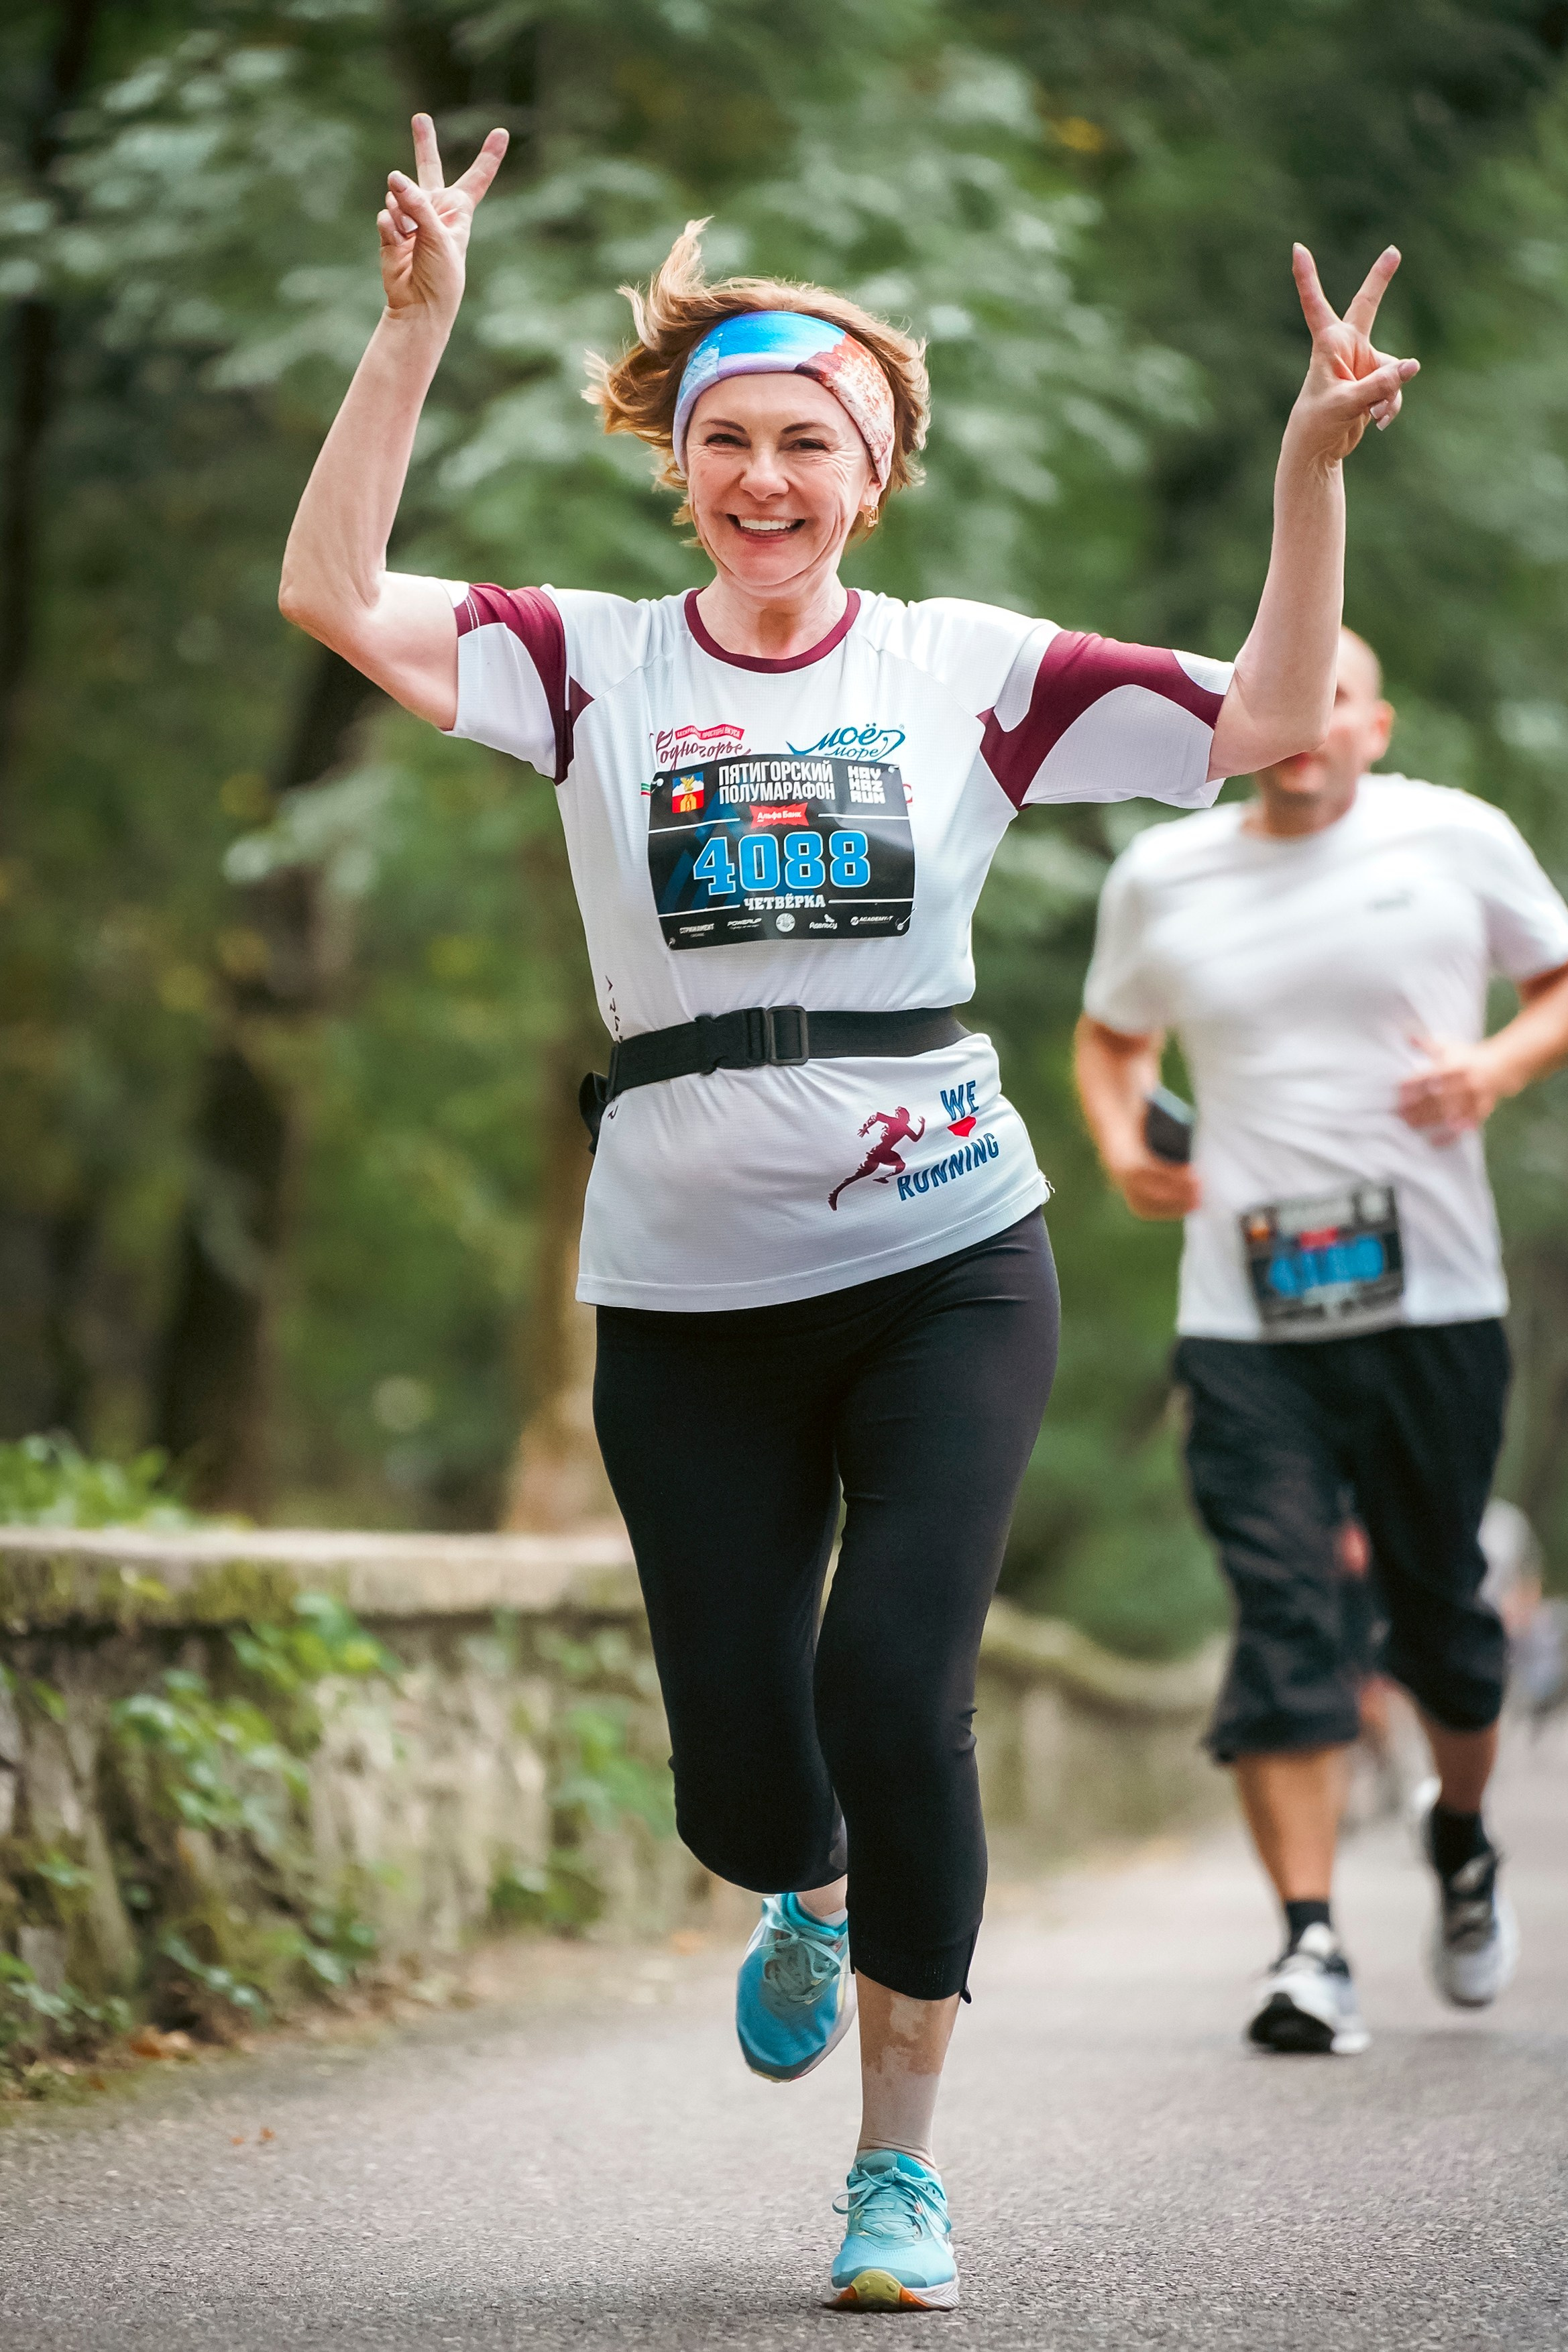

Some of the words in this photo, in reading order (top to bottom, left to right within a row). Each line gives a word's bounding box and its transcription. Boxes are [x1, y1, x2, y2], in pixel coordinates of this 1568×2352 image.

[719, 760, 834, 786] ПЯТИГОРСКИЙ
[719, 781, 836, 805] ПОЛУМАРАФОН
[850, 790, 886, 804] RUN
[757, 811, 782, 821] Альфа
[783, 810, 802, 818] Банк
[693, 830, 871, 896] 4088
[744, 893, 826, 911] ЧЕТВЁРКА
[940, 1080, 979, 1121] WE
[897, 1133, 999, 1202] RUNNING
